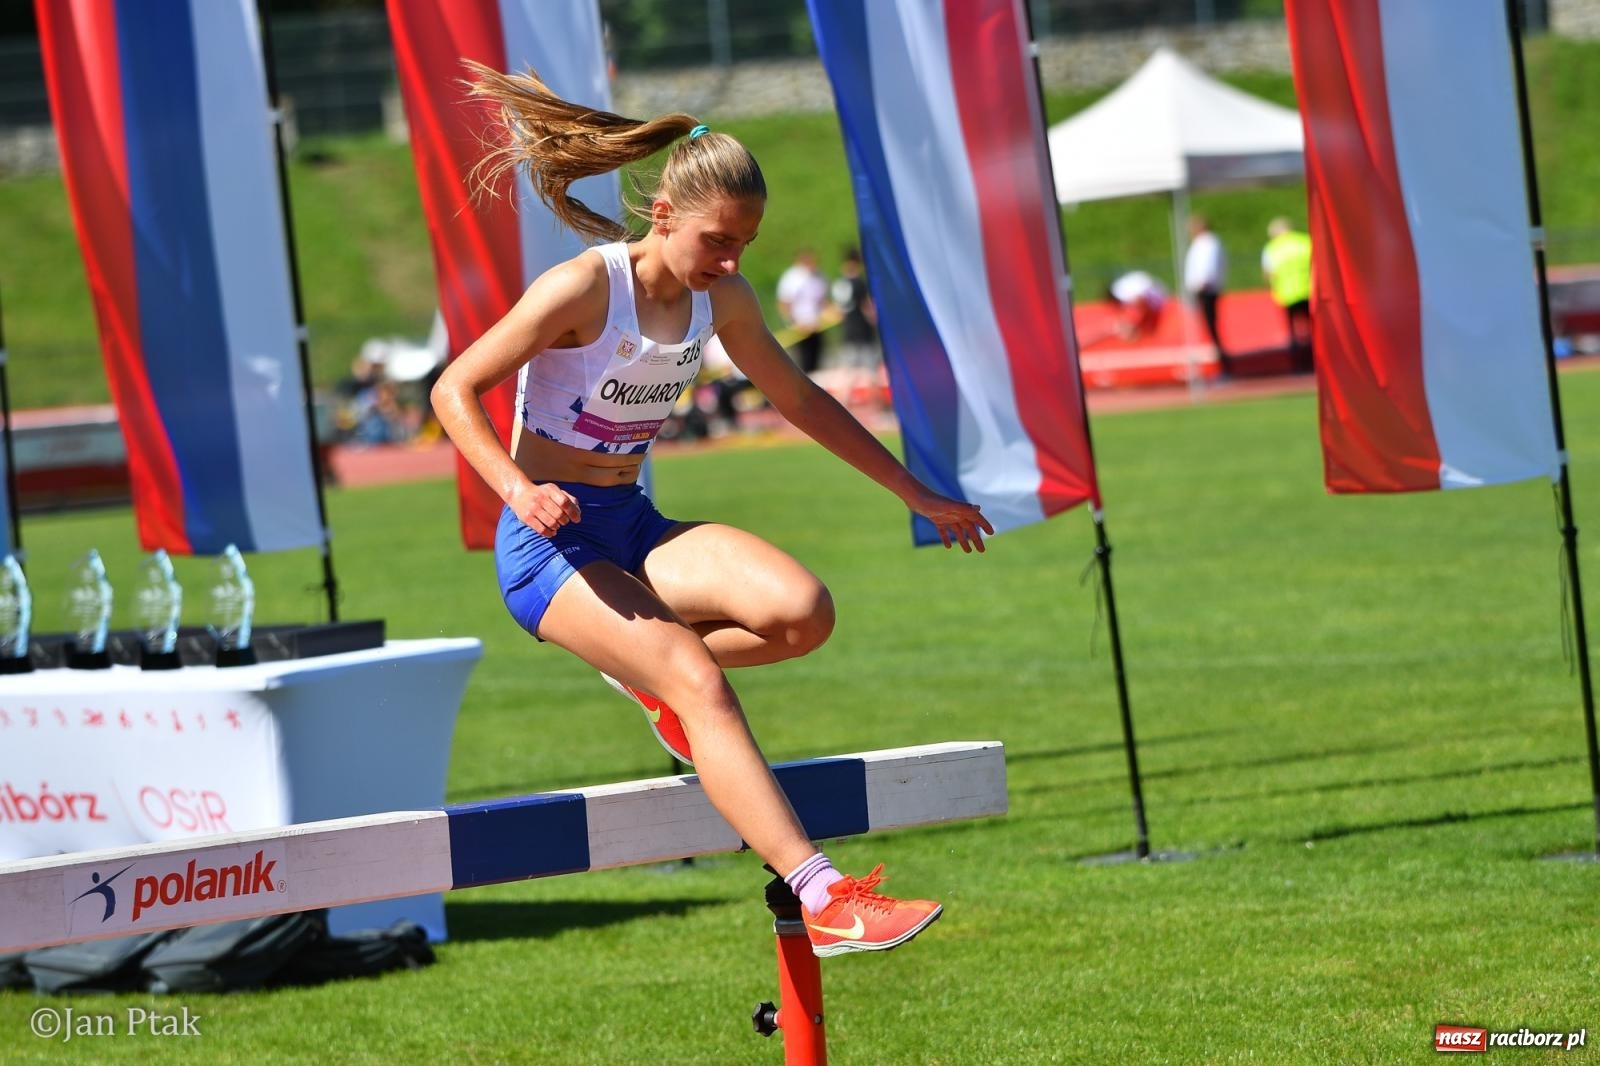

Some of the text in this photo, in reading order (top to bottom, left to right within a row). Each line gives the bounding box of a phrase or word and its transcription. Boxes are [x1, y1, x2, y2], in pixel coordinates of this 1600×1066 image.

[677, 338, 700, 366] 318
[0, 782, 108, 823] ibórz
[132, 850, 278, 922] polanik
